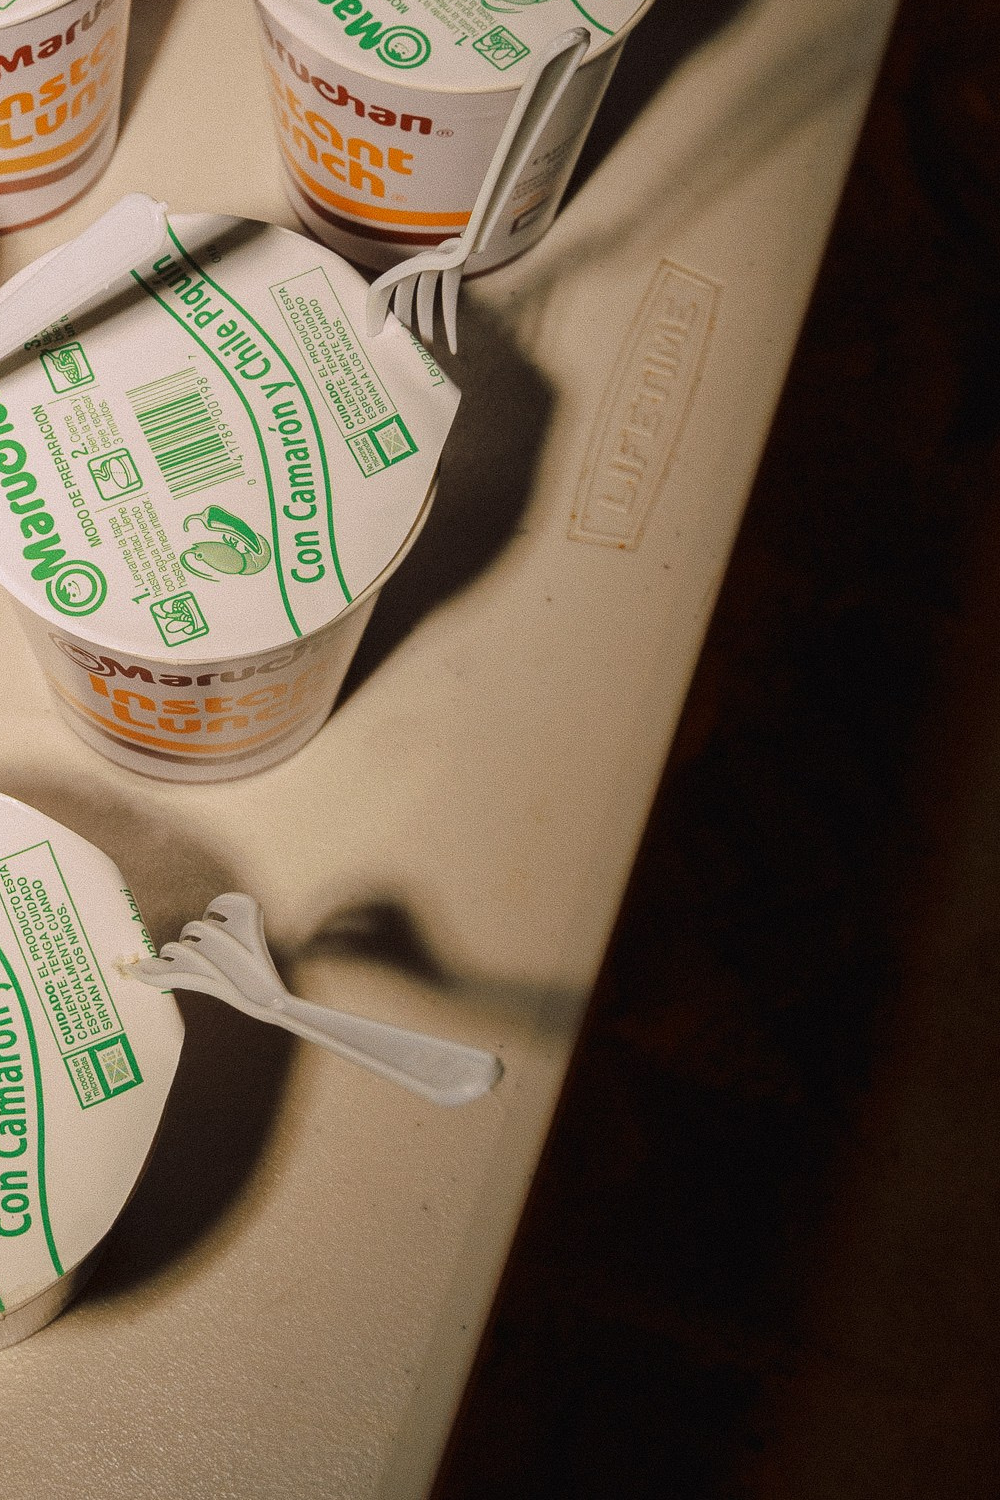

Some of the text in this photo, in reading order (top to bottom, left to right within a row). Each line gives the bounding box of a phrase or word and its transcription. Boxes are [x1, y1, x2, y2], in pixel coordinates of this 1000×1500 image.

[216, 319, 272, 380] Chile
[261, 380, 297, 400] y
[596, 296, 700, 516] LIFETIME
[31, 404, 103, 548] MODO DE PREPARACION
[268, 400, 318, 521] Camarón
[291, 530, 326, 584] Con
[0, 864, 75, 1045] CUIDADO: EL PRODUCTO ESTA
[17, 877, 87, 1040] CALIENTE. TENGA CUIDADO
[32, 880, 100, 1035] ESPECIALMENTE CUANDO
[57, 903, 113, 1030] SIRVAN A LOS NIÑOS.
